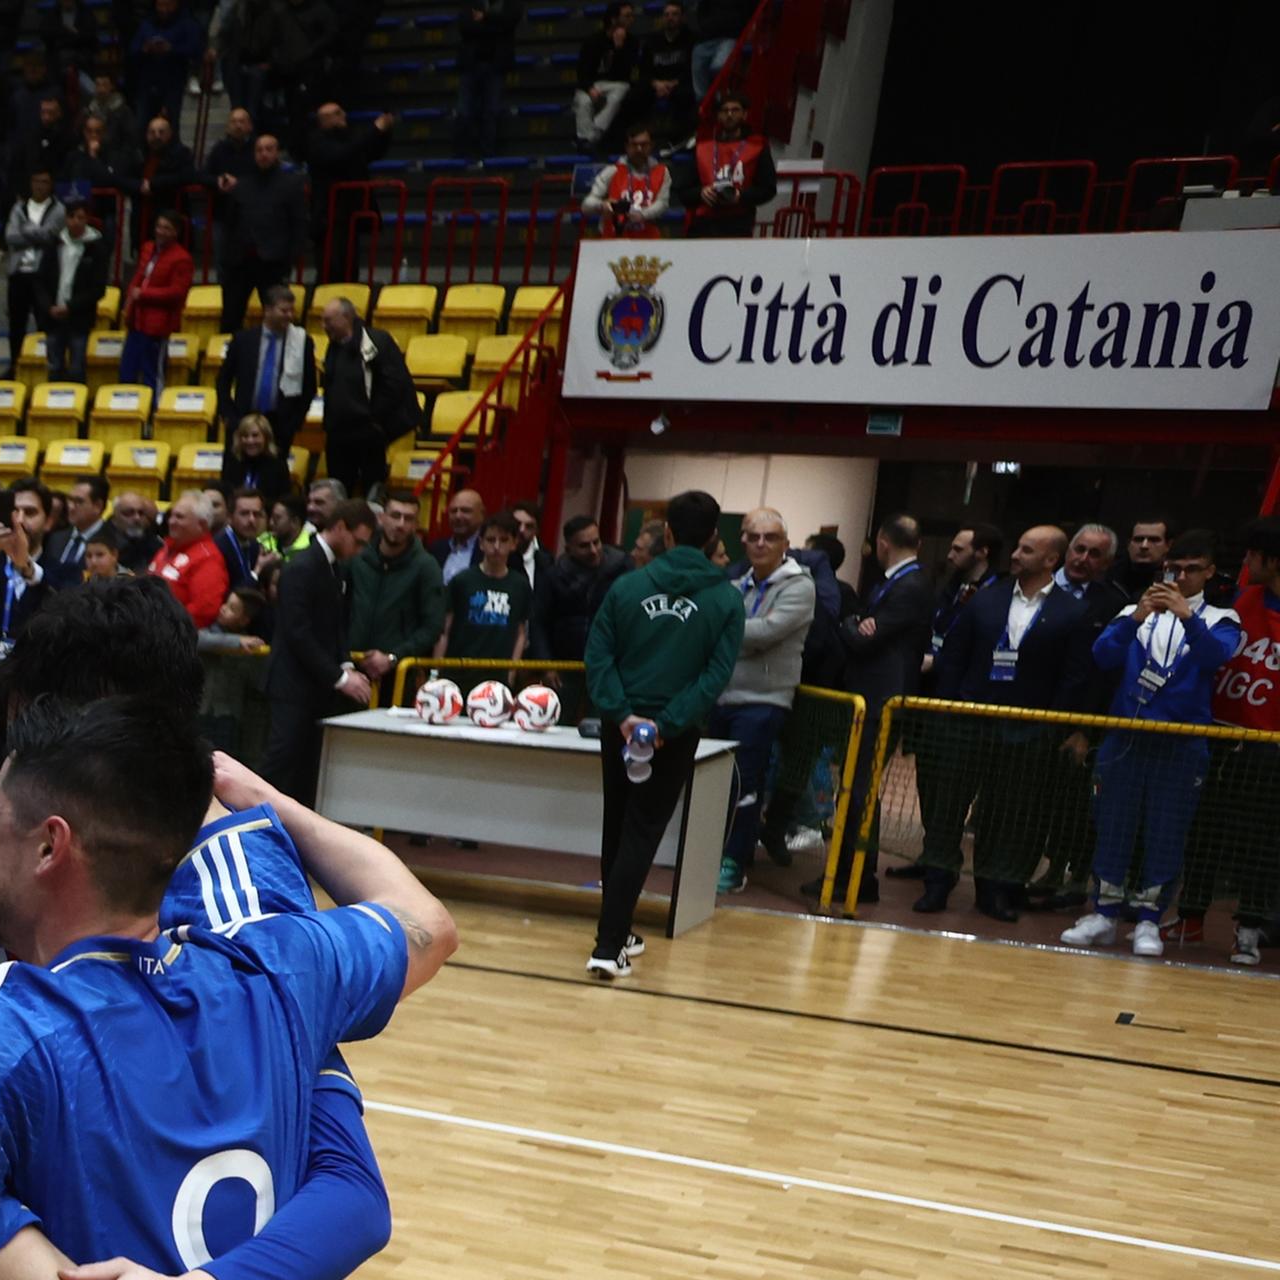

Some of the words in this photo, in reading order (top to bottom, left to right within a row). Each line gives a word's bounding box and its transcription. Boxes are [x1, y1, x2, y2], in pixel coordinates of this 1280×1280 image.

[688, 274, 847, 364] Città
[871, 275, 942, 367] di
[961, 271, 1252, 369] Catania
[641, 593, 698, 622] UEFA
[1215, 666, 1273, 705] IGC
